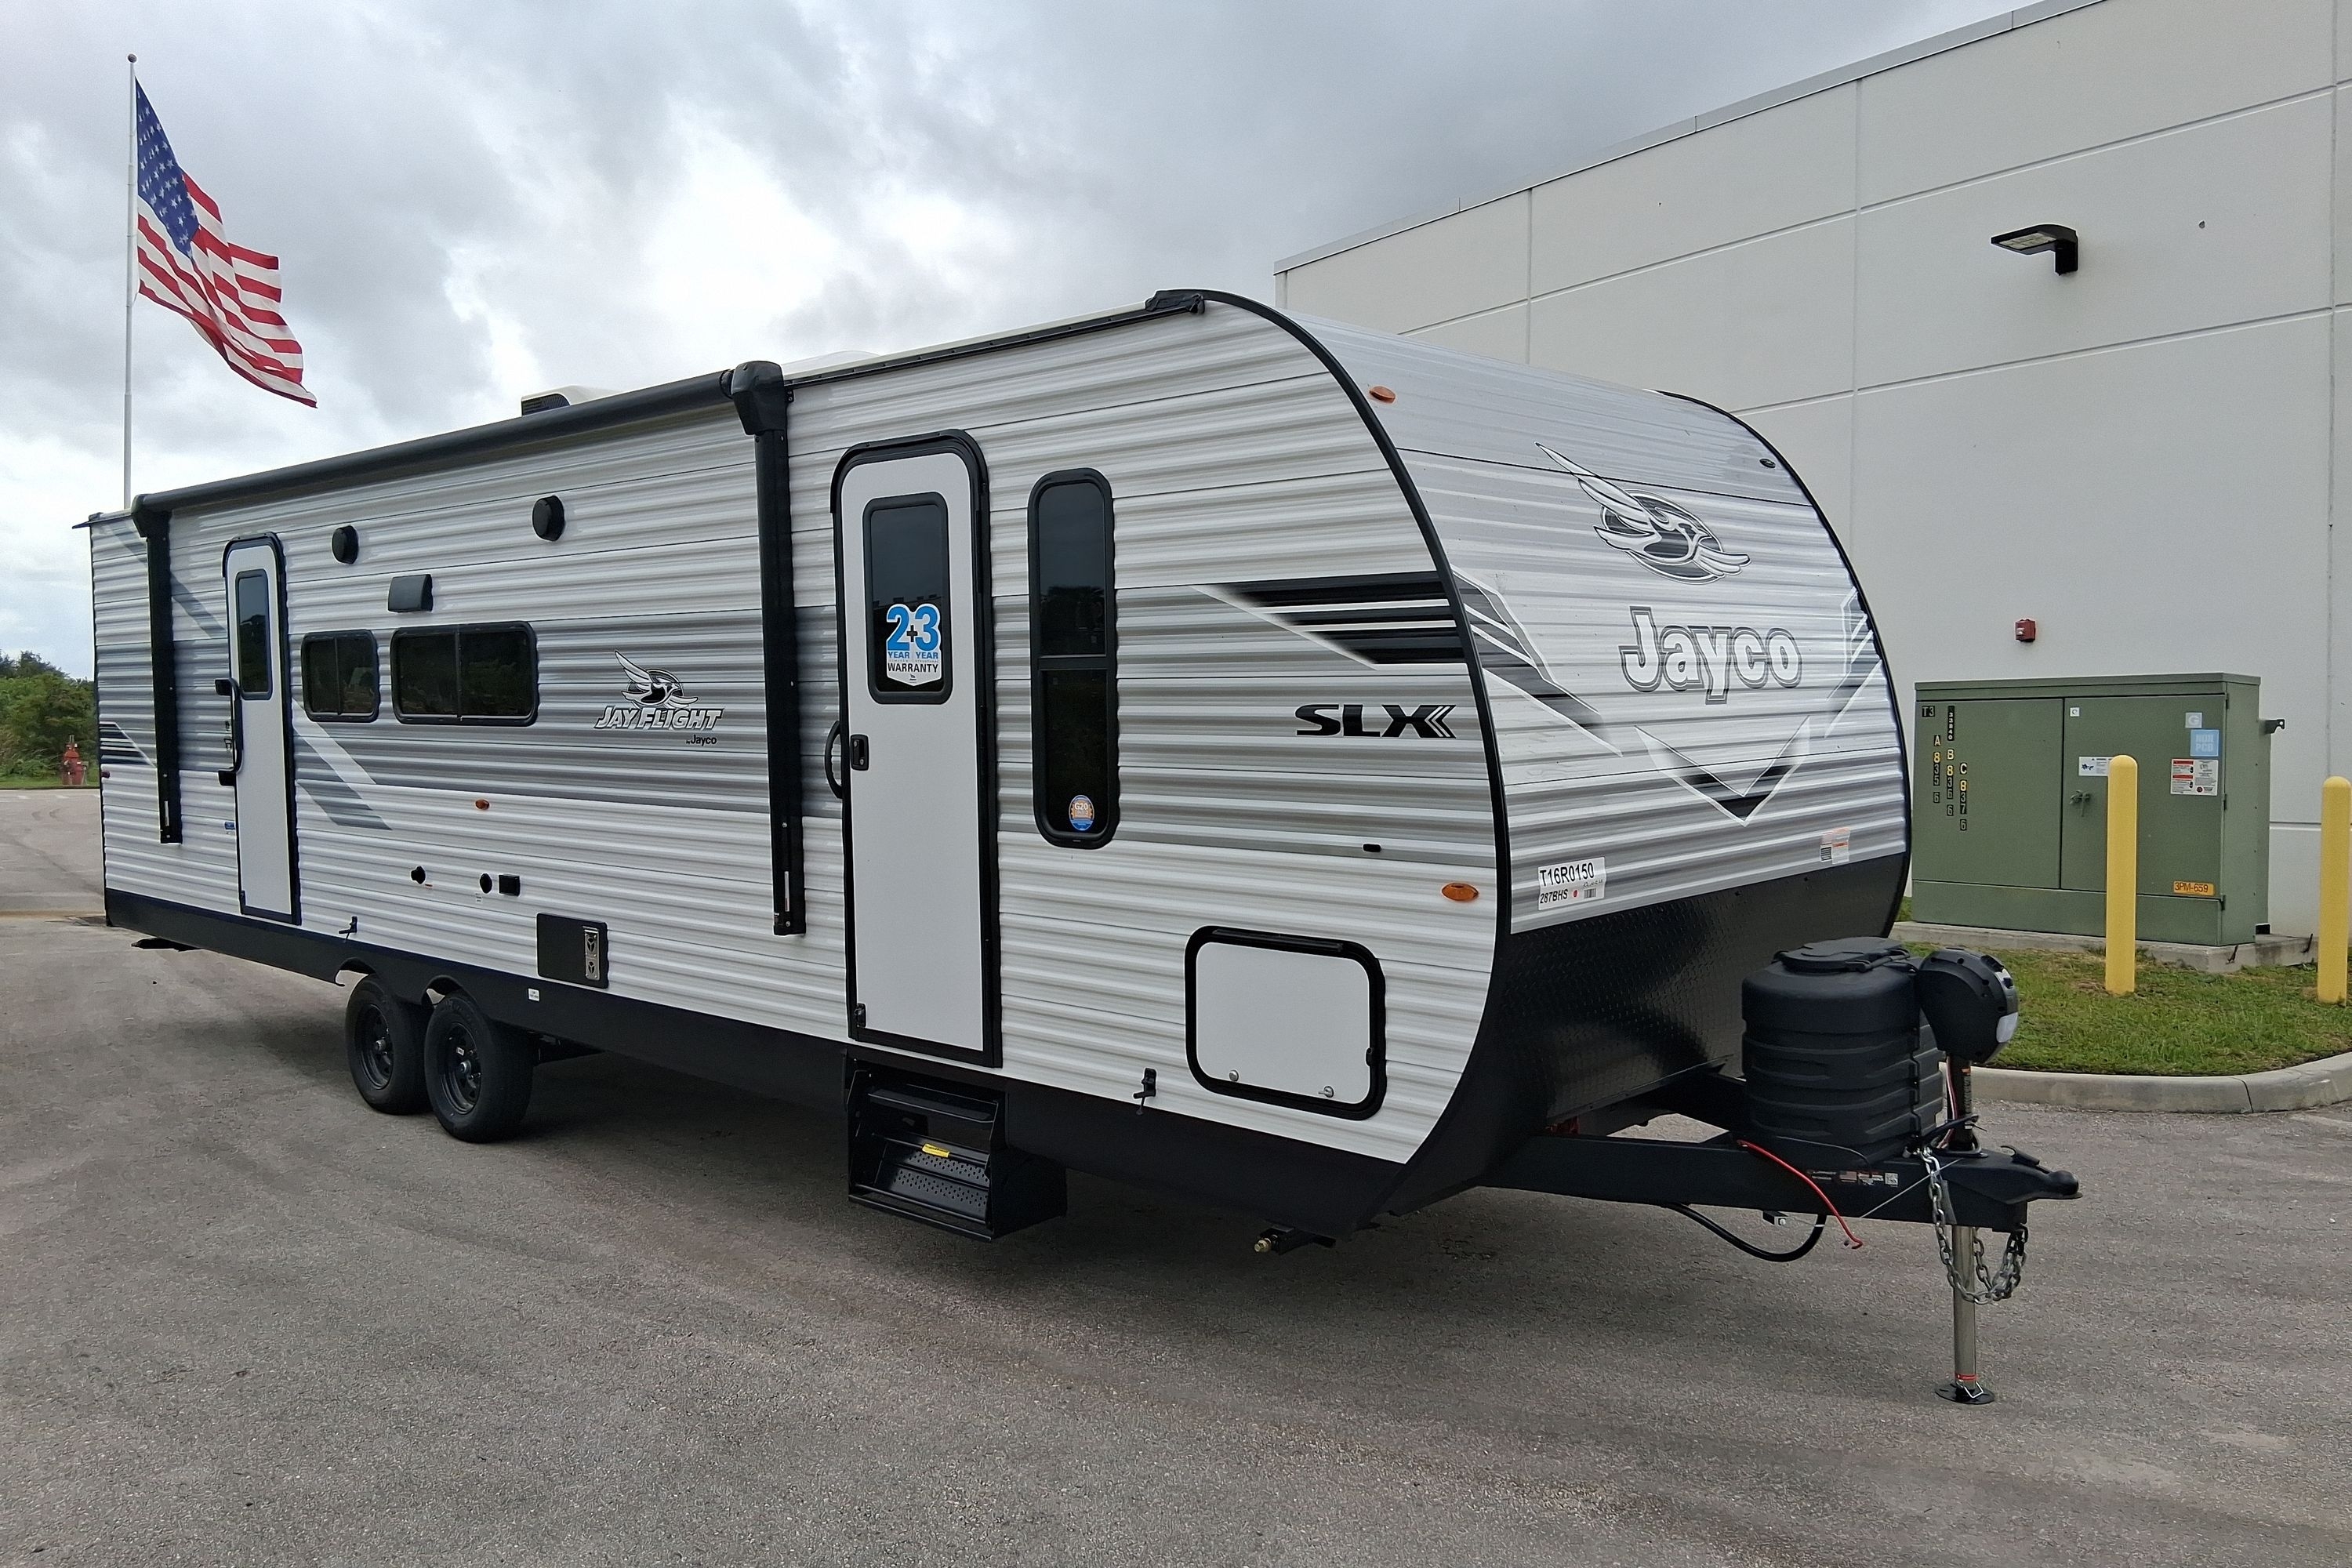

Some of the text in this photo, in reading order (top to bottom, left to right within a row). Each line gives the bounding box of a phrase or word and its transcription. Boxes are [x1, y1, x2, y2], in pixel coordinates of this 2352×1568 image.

[1618, 605, 1802, 705] Jayco
[887, 662, 938, 673] WARRANTY
[1922, 706, 1935, 717] T3
[1294, 703, 1457, 739] SLX
[691, 735, 717, 746] Jayco
[1934, 735, 1941, 746] A
[1947, 749, 1955, 760] B
[1960, 763, 1968, 775] C
[1539, 862, 1595, 887] T16R0150
[2175, 882, 2209, 893] 3PM-659
[1539, 888, 1569, 904] 287BHS
